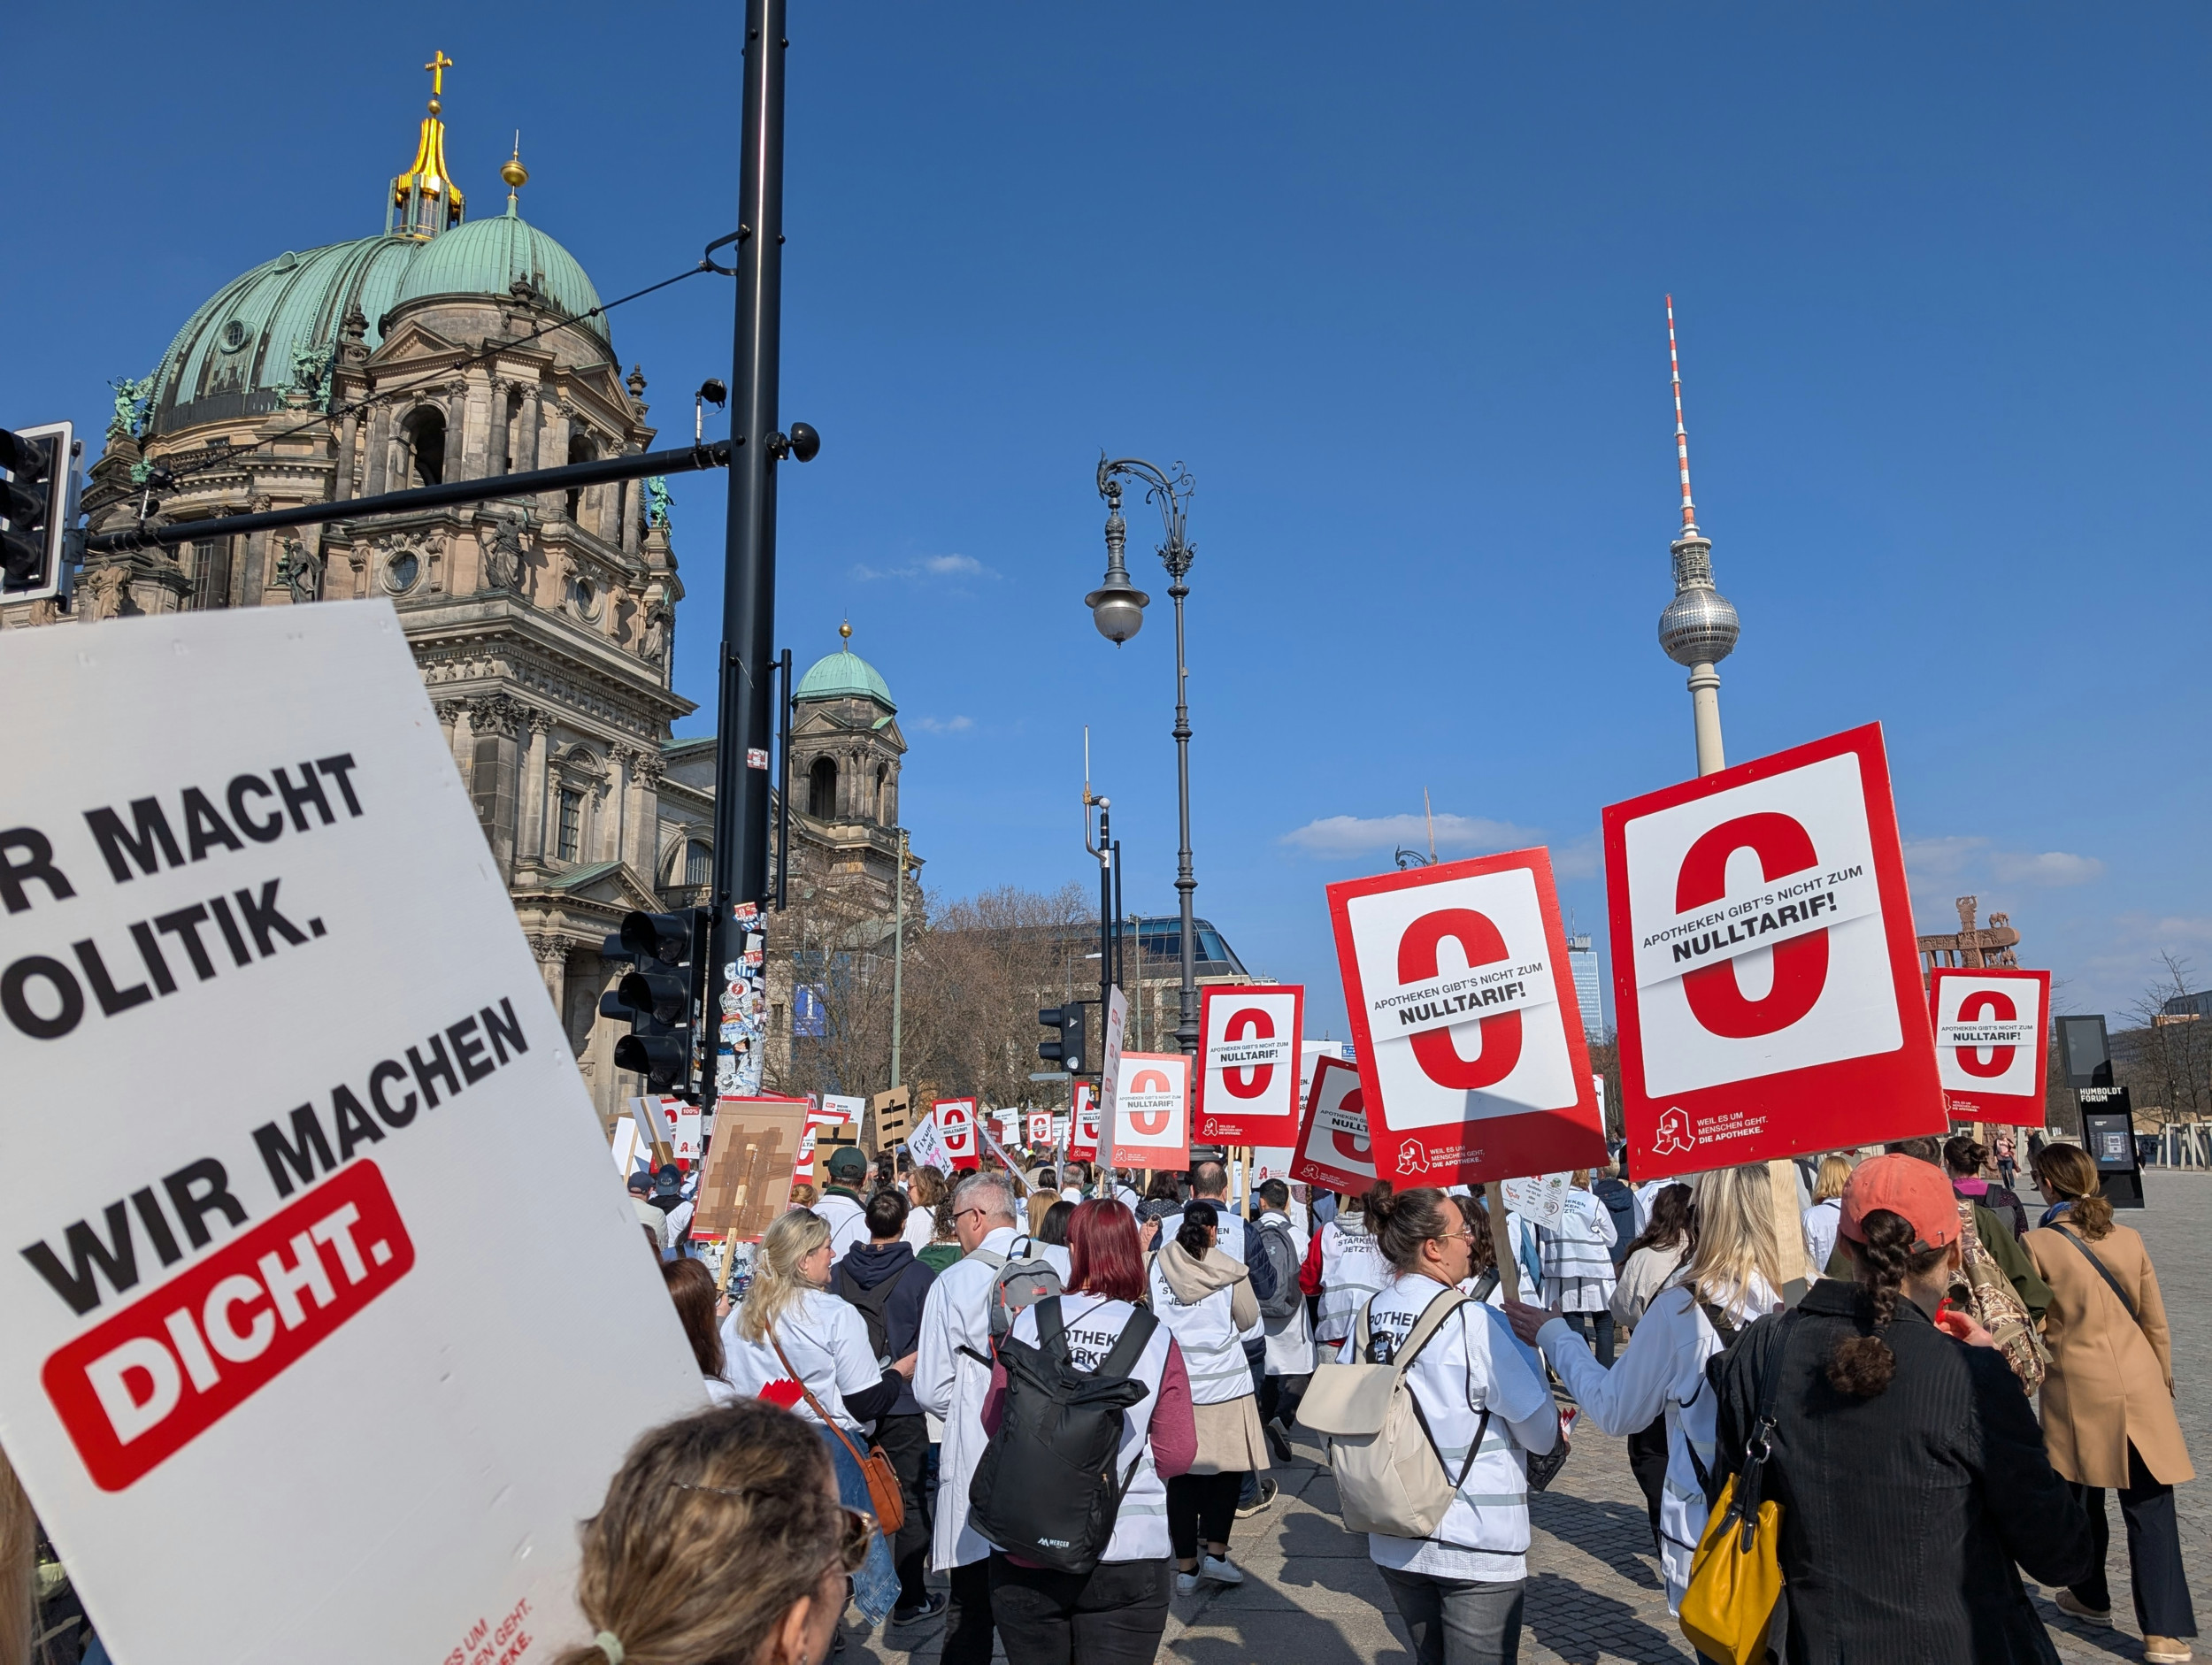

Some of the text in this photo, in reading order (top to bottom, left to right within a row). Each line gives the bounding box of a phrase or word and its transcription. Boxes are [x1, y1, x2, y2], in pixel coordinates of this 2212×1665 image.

[82, 753, 365, 884] MACHT
[1643, 865, 1863, 948] APOTHEKEN GIBT'S NICHT ZUM
[1671, 891, 1838, 963] NULLTARIF!
[2, 879, 327, 1041] OLITIK.
[1374, 962, 1543, 1010] APOTHEKEN GIBT'S NICHT ZUM
[1399, 982, 1526, 1025] NULLTARIF!
[1953, 1032, 2021, 1041] NULLTARIF!
[1220, 1049, 1279, 1063] NULLTARIF!
[1320, 1109, 1358, 1122] APOTHEKEN
[1332, 1118, 1369, 1132] NULLT
[1697, 1117, 1717, 1126] WEIL
[1730, 1111, 1743, 1120] UM
[1698, 1116, 1769, 1135] MENSCHEN GEHT.
[913, 1123, 933, 1154] Fixum
[926, 1133, 936, 1156] rauf
[1699, 1126, 1763, 1145] DIE APOTHEKE.
[19, 997, 529, 1317] WIR MACHEN
[1431, 1152, 1465, 1161] MENSCHEN
[1445, 1157, 1482, 1166] APOTHEKE.
[84, 1202, 393, 1446] DICHT.
[464, 1617, 488, 1652] UM
[495, 1598, 533, 1646] GEHT.
